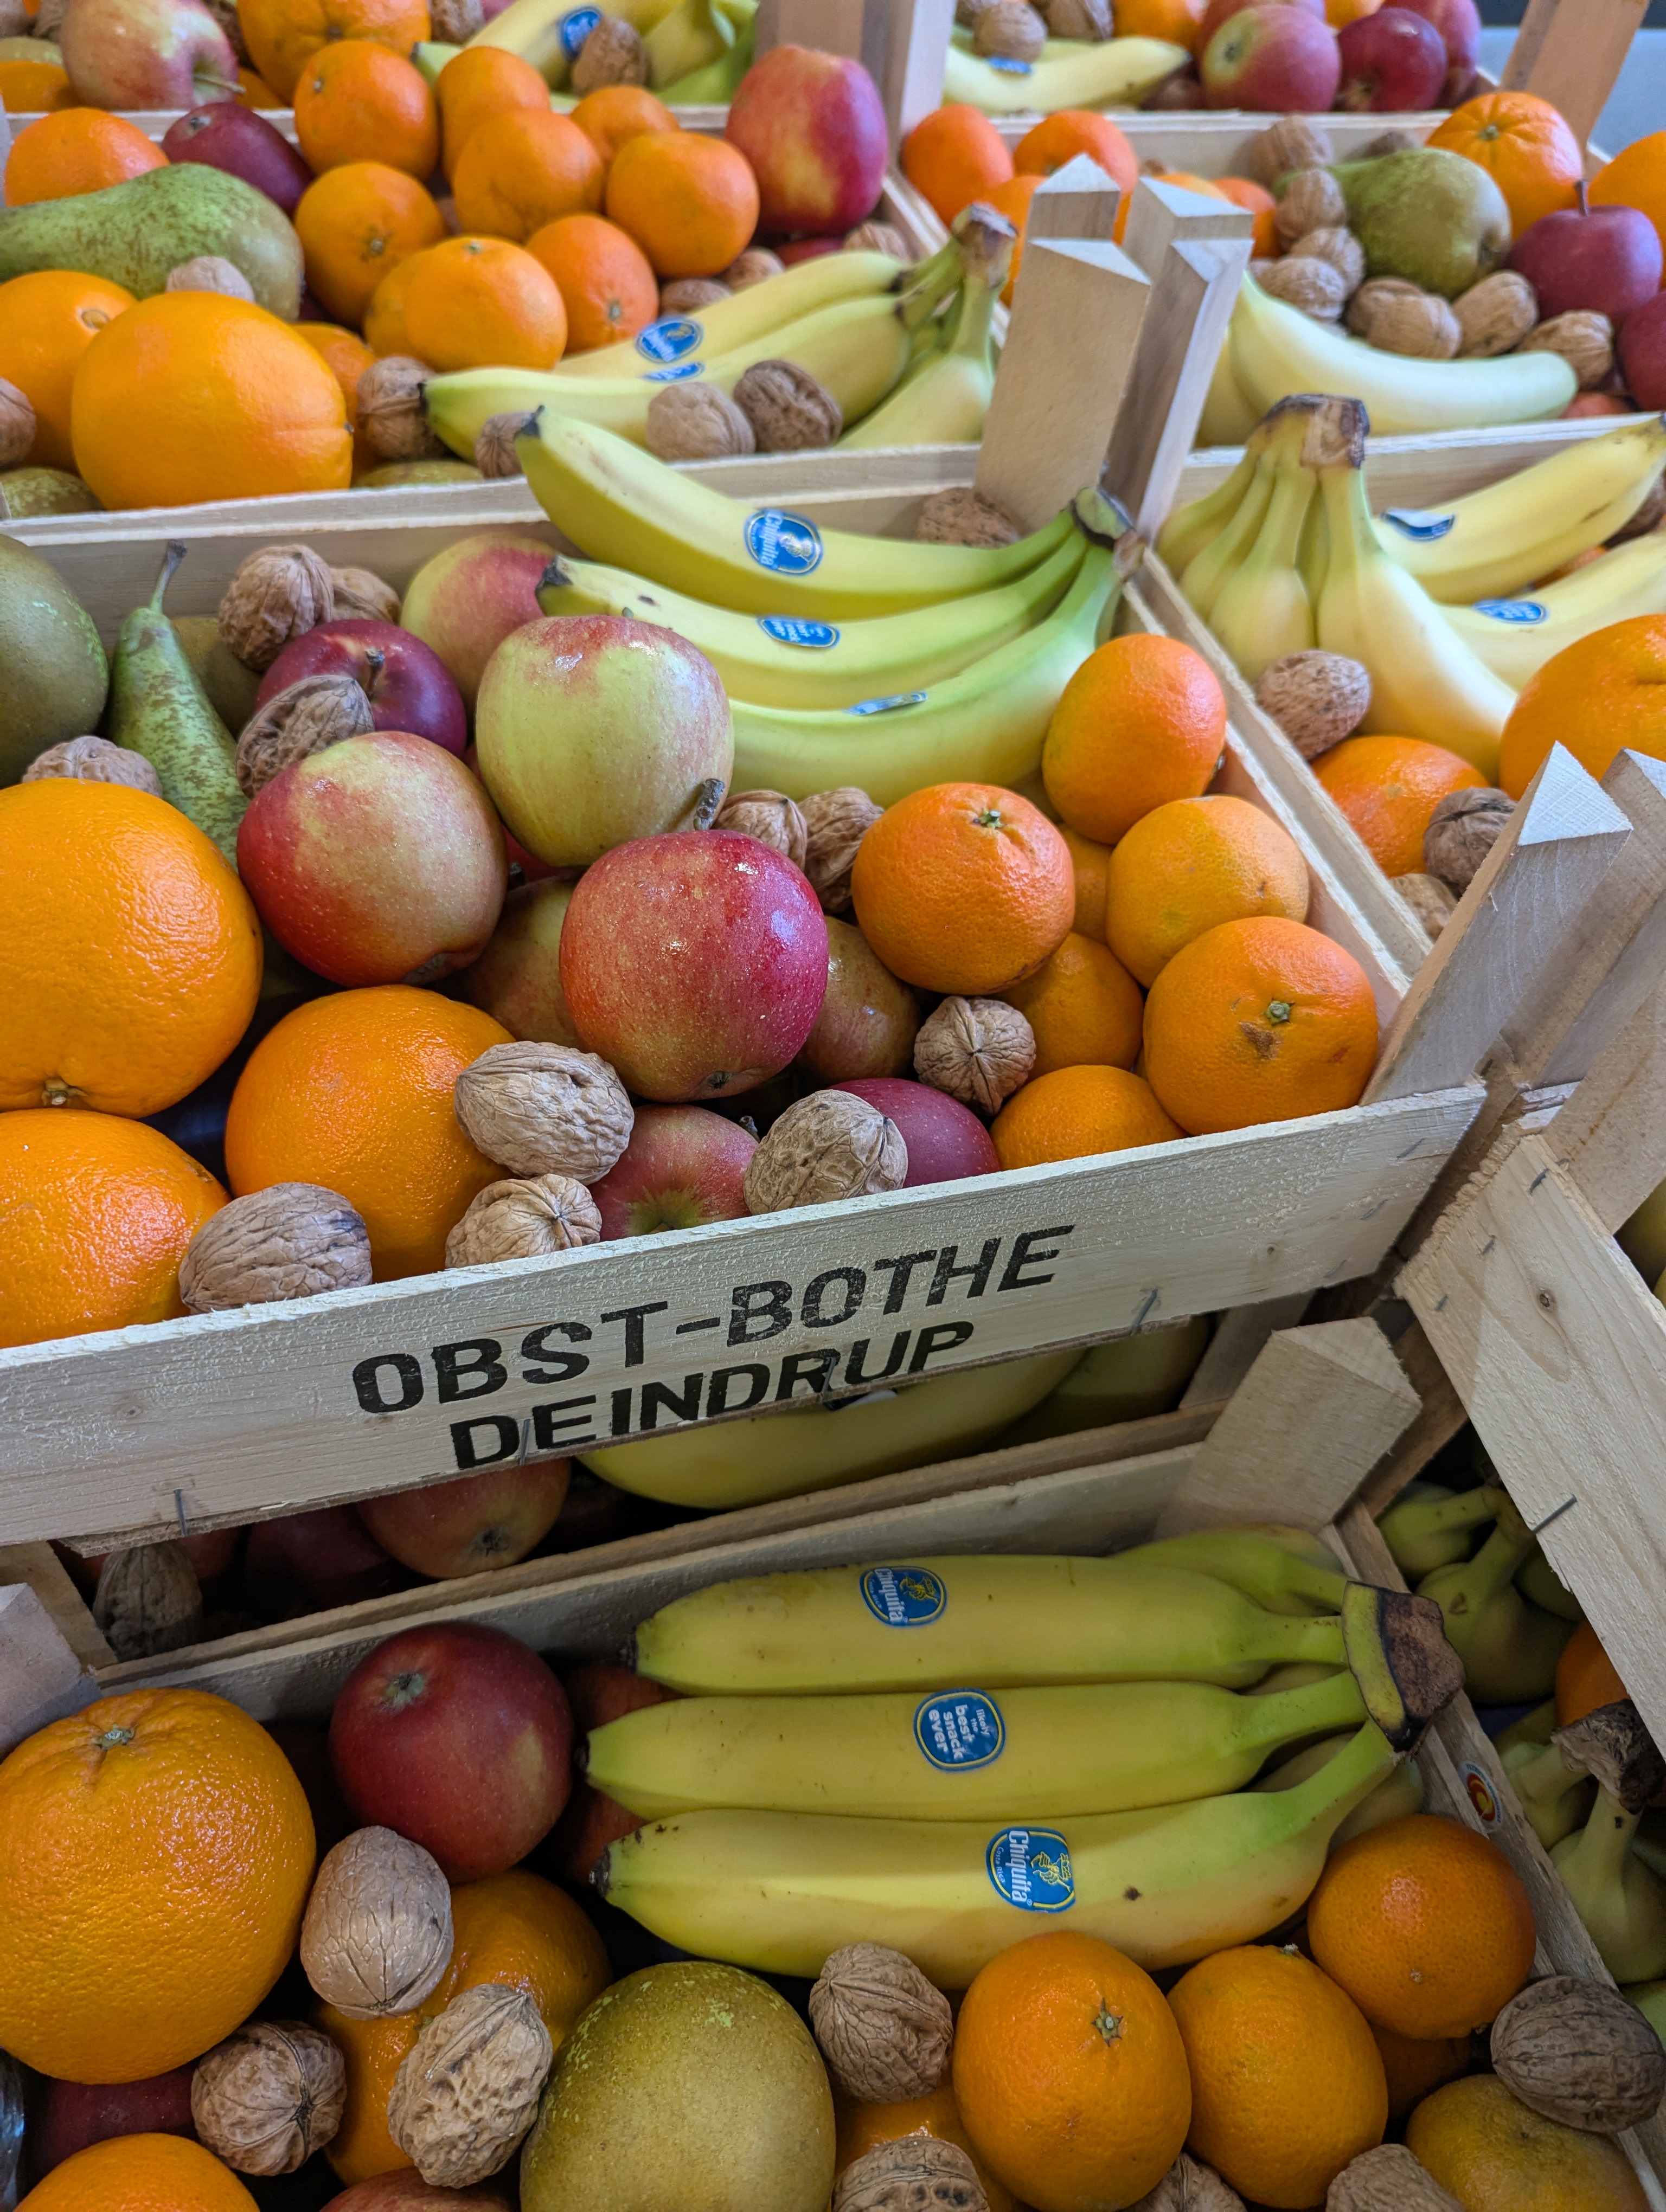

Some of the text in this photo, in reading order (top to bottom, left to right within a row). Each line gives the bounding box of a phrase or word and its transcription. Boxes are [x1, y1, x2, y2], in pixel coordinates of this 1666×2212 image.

[352, 1224, 1075, 1413] OBST-BOTHE
[450, 1321, 974, 1469] DEINDRUP
[874, 1568, 905, 1621] Chiquita
[928, 1709, 948, 1752] ever
[943, 1711, 965, 1759] snack
[955, 1704, 975, 1742] best
[970, 1718, 978, 1732] the
[976, 1708, 990, 1735] likely
[995, 1847, 1005, 1883] Costa Rica
[1005, 1830, 1031, 1902] Chiquita
